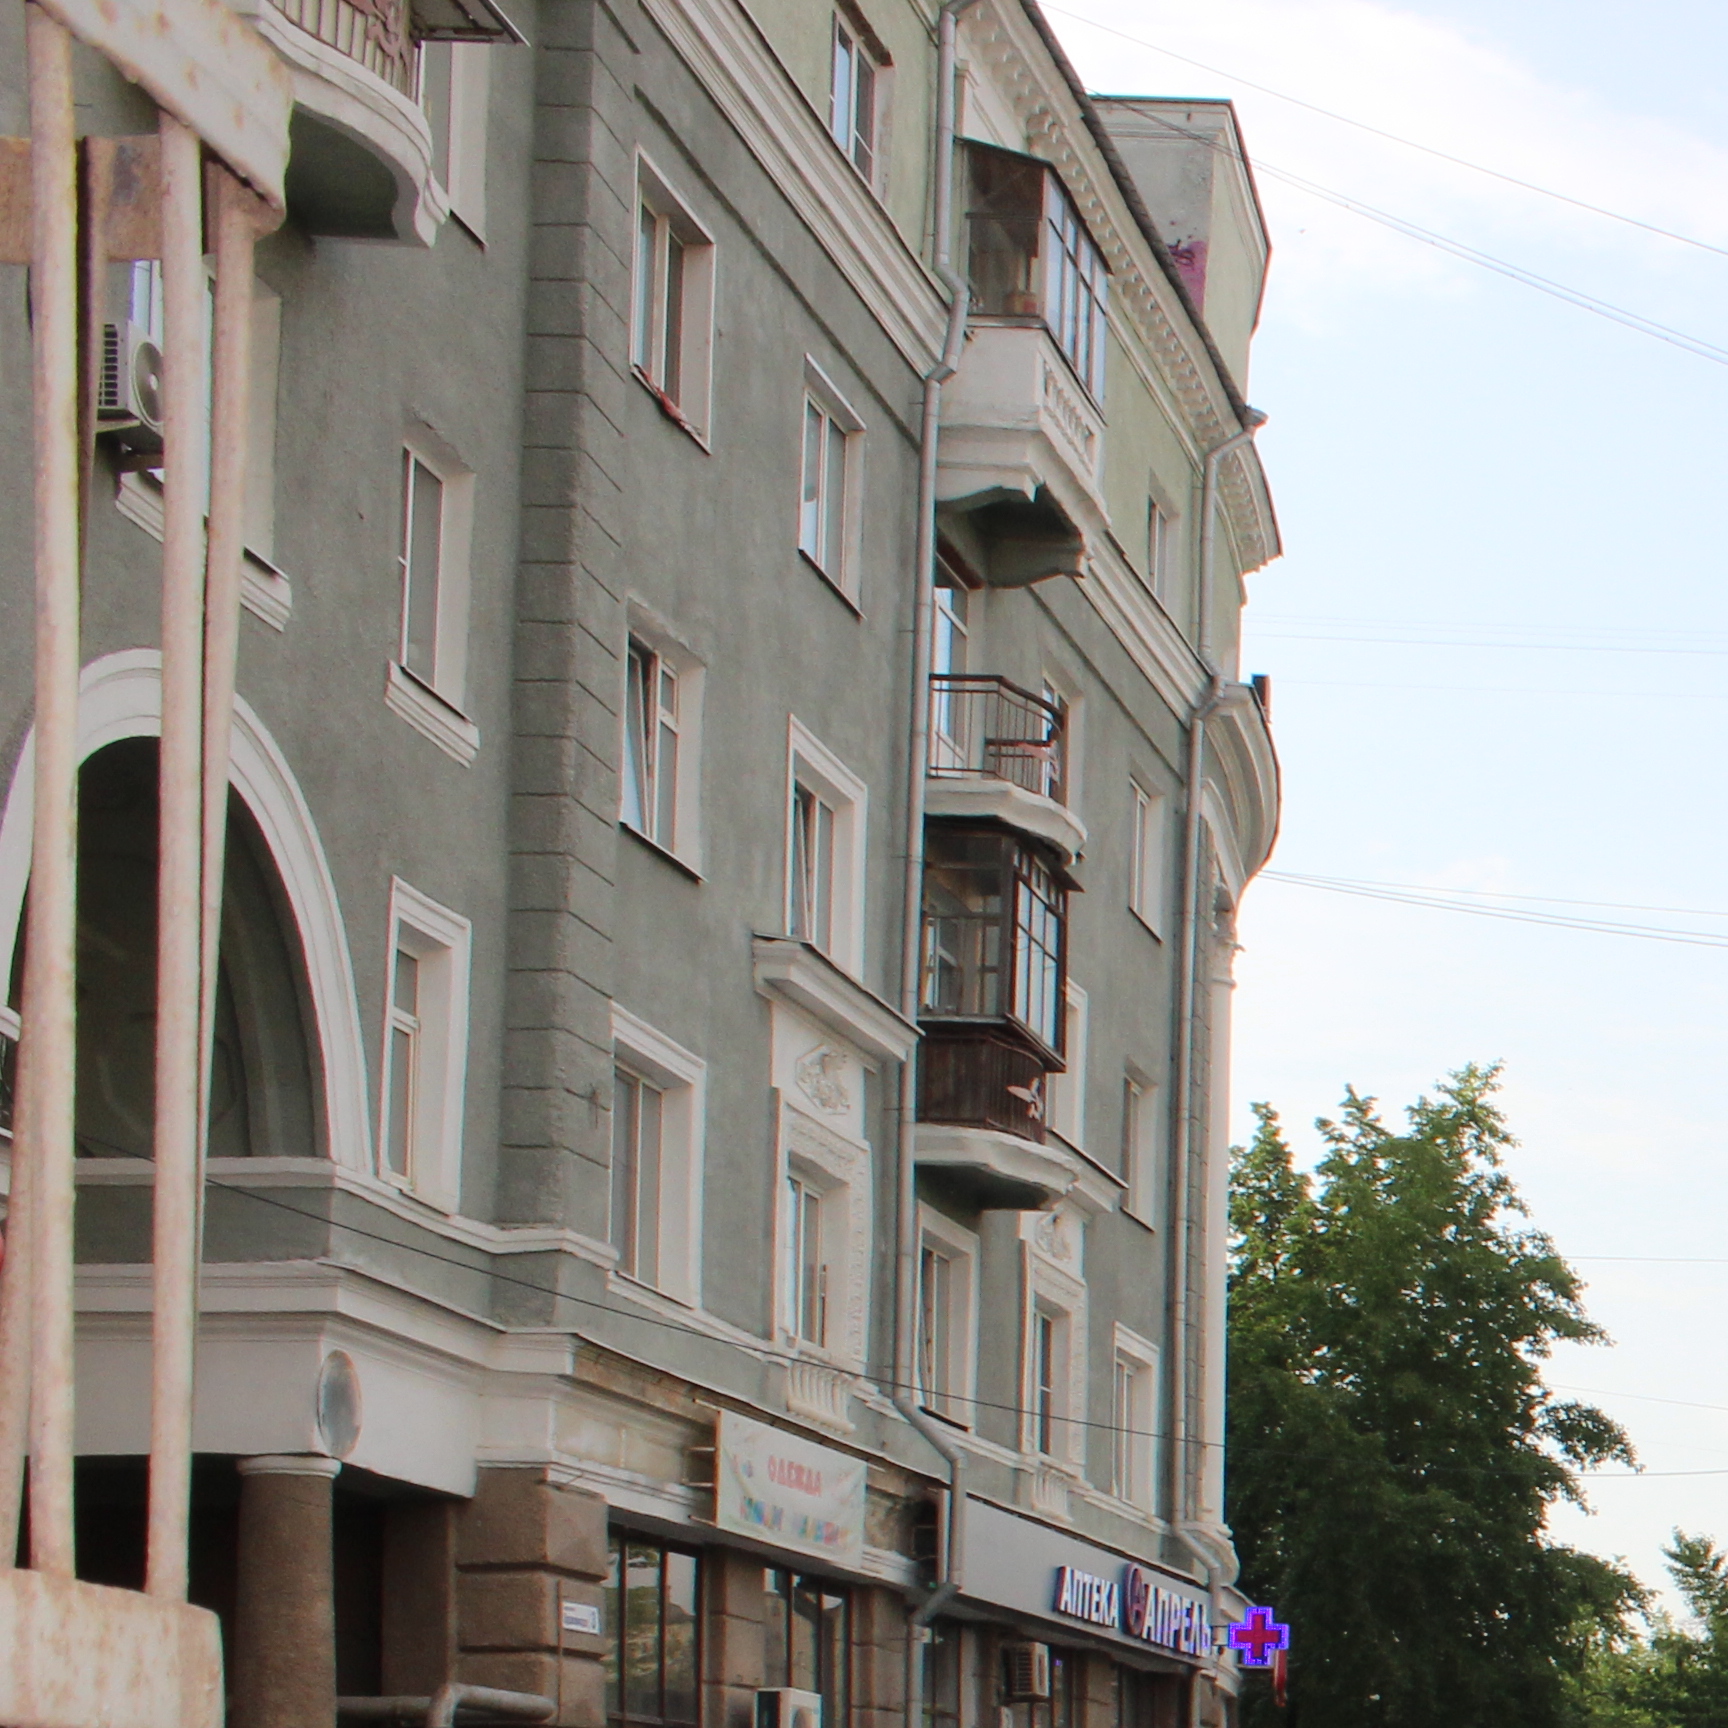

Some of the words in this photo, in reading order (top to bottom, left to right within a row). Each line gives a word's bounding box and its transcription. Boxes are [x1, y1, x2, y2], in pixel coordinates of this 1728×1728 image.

[767, 1455, 822, 1497] ОДЕЖДА
[1058, 1565, 1119, 1629] АПТЕКА
[1141, 1583, 1212, 1659] АПРЕЛЬ
